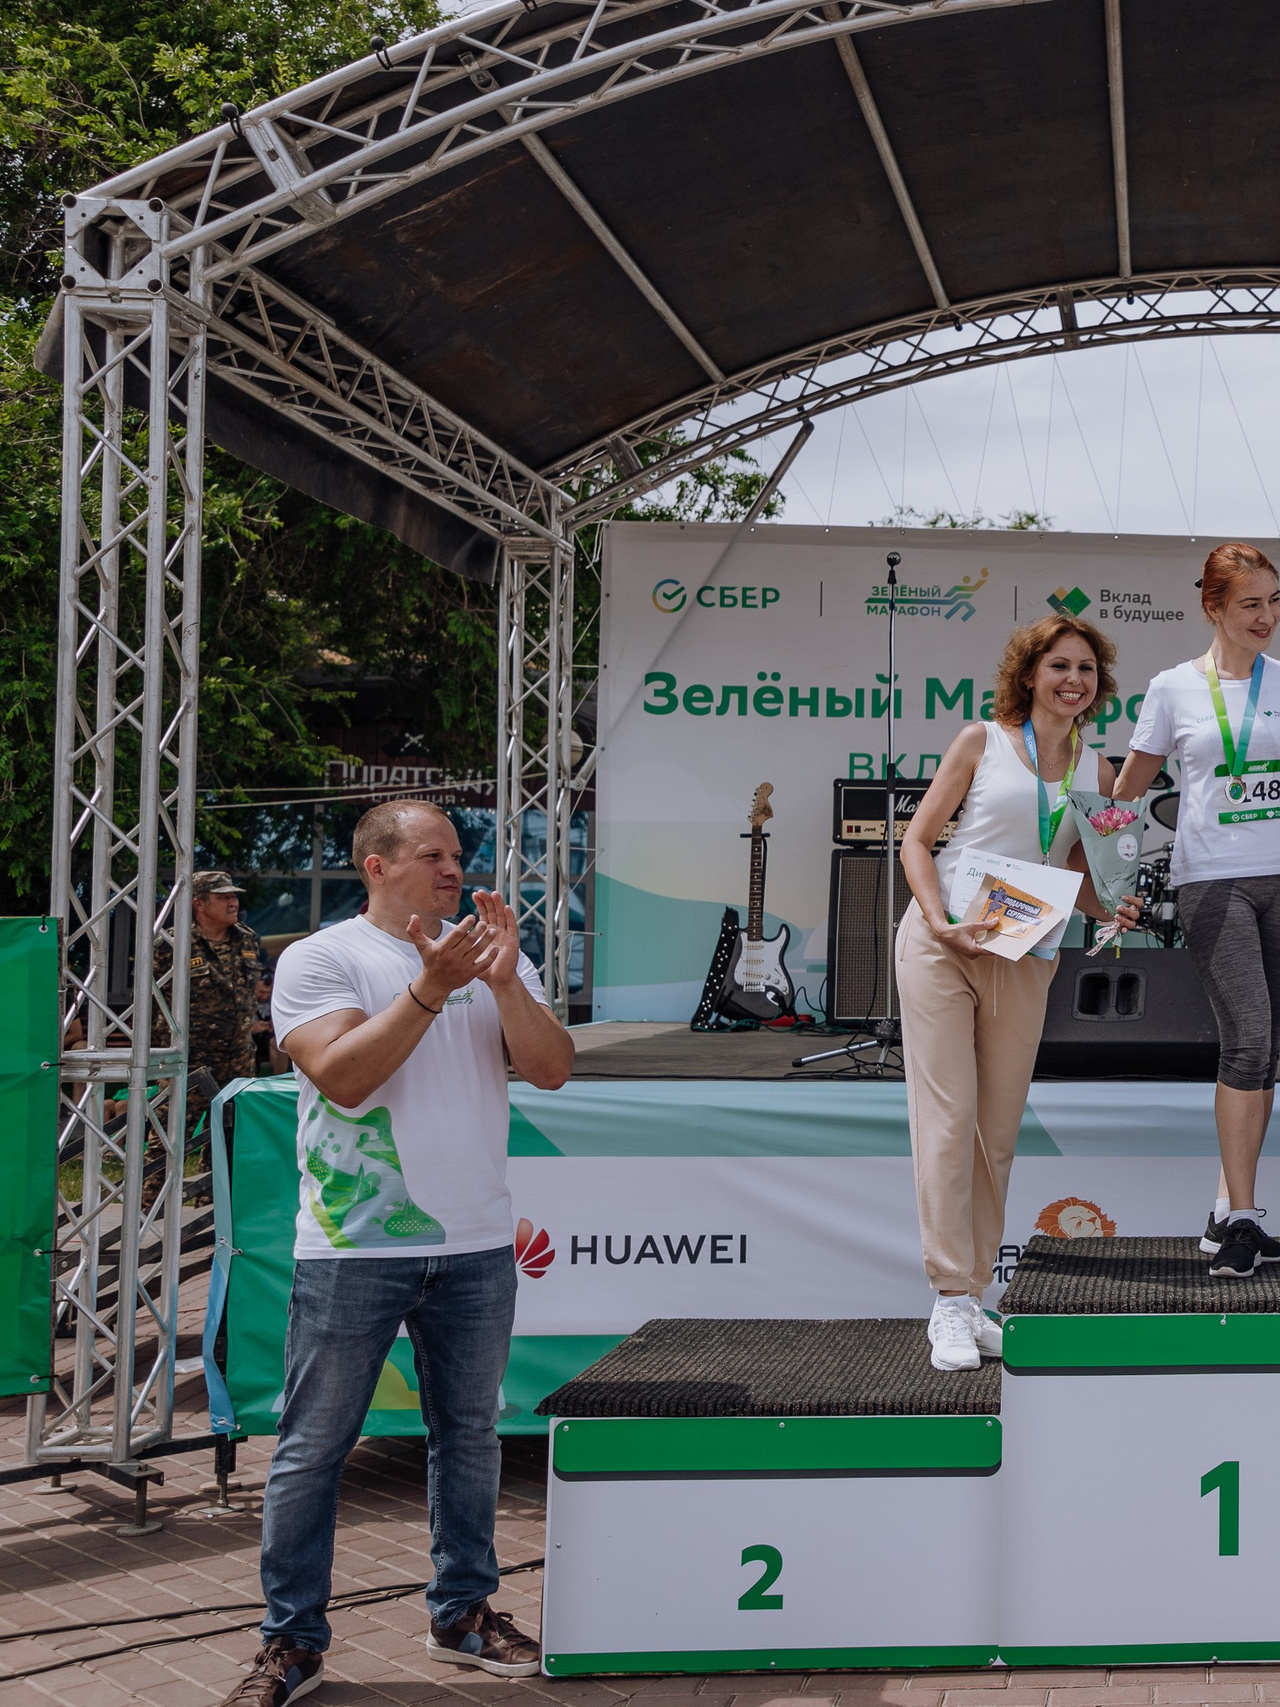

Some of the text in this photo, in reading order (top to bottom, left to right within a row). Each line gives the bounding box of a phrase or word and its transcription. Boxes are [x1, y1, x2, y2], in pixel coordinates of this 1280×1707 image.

[697, 585, 780, 609] СБЕР
[1101, 589, 1151, 606] Вклад
[866, 605, 941, 616] МААФОН
[1101, 606, 1185, 622] в будущее
[643, 671, 902, 719] Зелёный
[1004, 897, 1041, 915] ПОДАРОЧНЫЙ
[571, 1234, 747, 1265] HUAWEI
[1200, 1460, 1240, 1557] 1
[737, 1545, 784, 1610] 2
